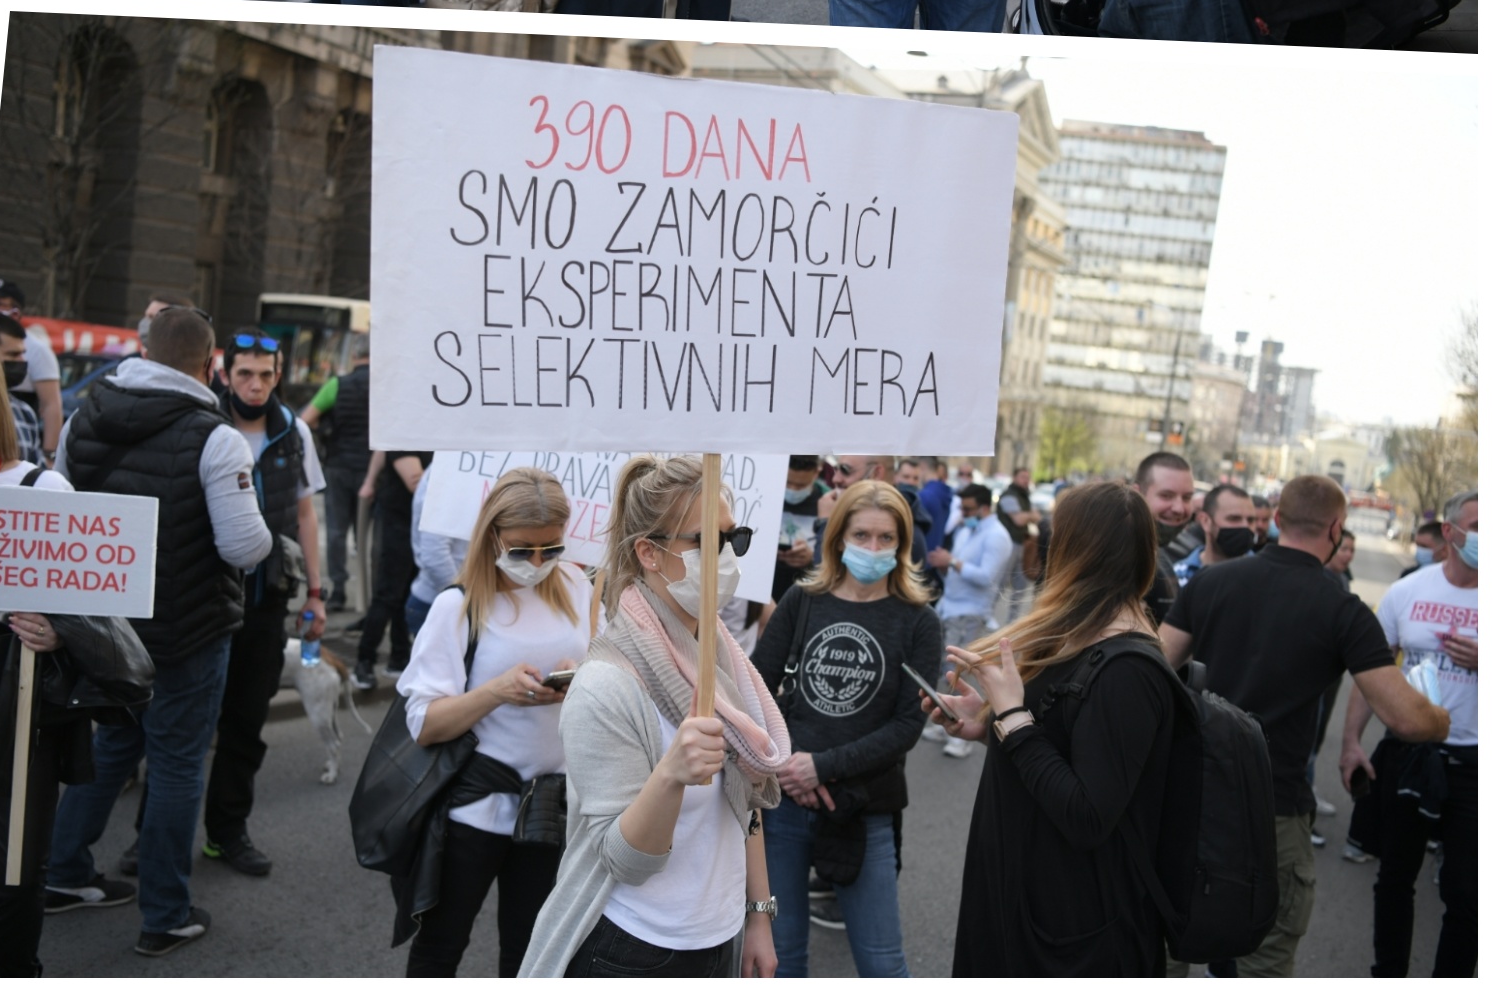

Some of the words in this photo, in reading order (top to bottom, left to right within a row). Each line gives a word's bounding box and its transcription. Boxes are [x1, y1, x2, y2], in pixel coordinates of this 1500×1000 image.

[525, 94, 632, 175] 390
[661, 110, 811, 183] DANA
[449, 169, 577, 250] SMO
[604, 181, 897, 270] ZAMORČIĆI
[483, 254, 857, 340] EKSPERIMENTA
[431, 331, 777, 413] SELEKTIVNIH
[809, 347, 939, 417] MERA
[68, 514, 121, 537] NAS
[95, 544, 136, 566] OD
[46, 568, 127, 593] RADA!
[821, 625, 870, 645] AUTHENTIC
[830, 649, 855, 662] 1919
[805, 657, 876, 684] Champion
[813, 698, 855, 714] ATHLETIC
